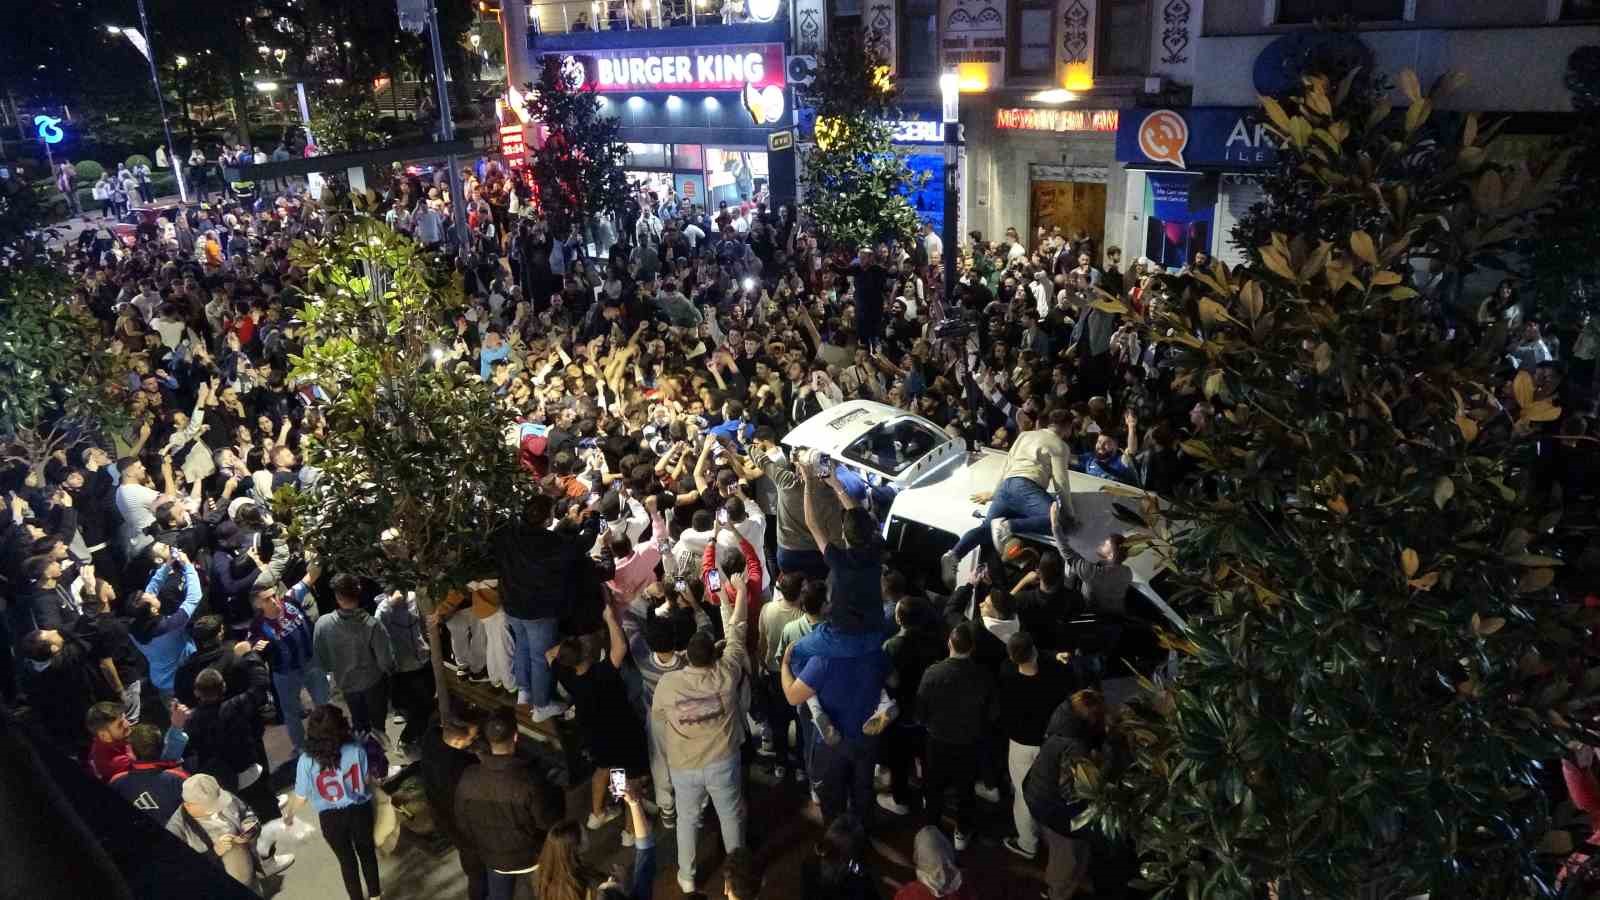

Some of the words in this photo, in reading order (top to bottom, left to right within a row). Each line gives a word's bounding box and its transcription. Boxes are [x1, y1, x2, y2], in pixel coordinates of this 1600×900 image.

[598, 56, 693, 84] BURGER
[697, 53, 764, 83] KING
[316, 763, 361, 801] 61
